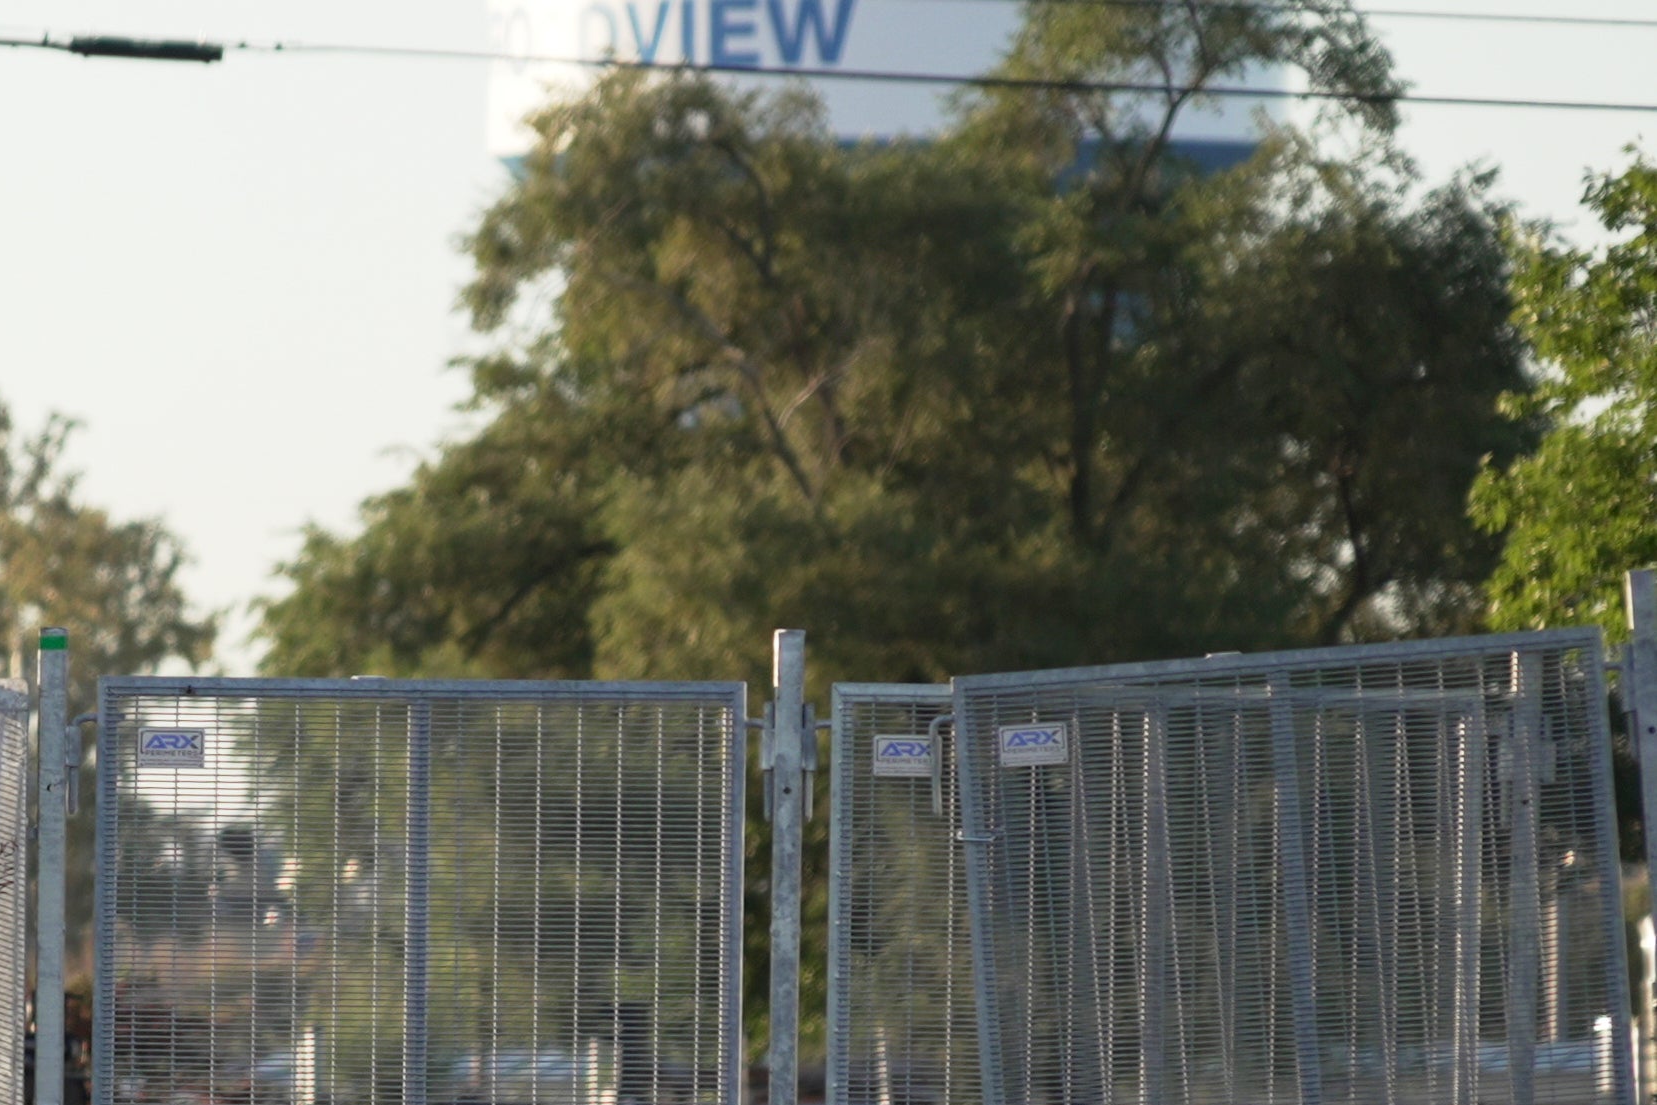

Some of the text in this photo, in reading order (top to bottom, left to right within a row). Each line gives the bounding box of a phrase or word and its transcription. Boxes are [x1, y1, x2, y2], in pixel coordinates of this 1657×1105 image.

[144, 735, 200, 750] ARX
[1007, 730, 1061, 748] ARX
[880, 742, 931, 757] ARX
